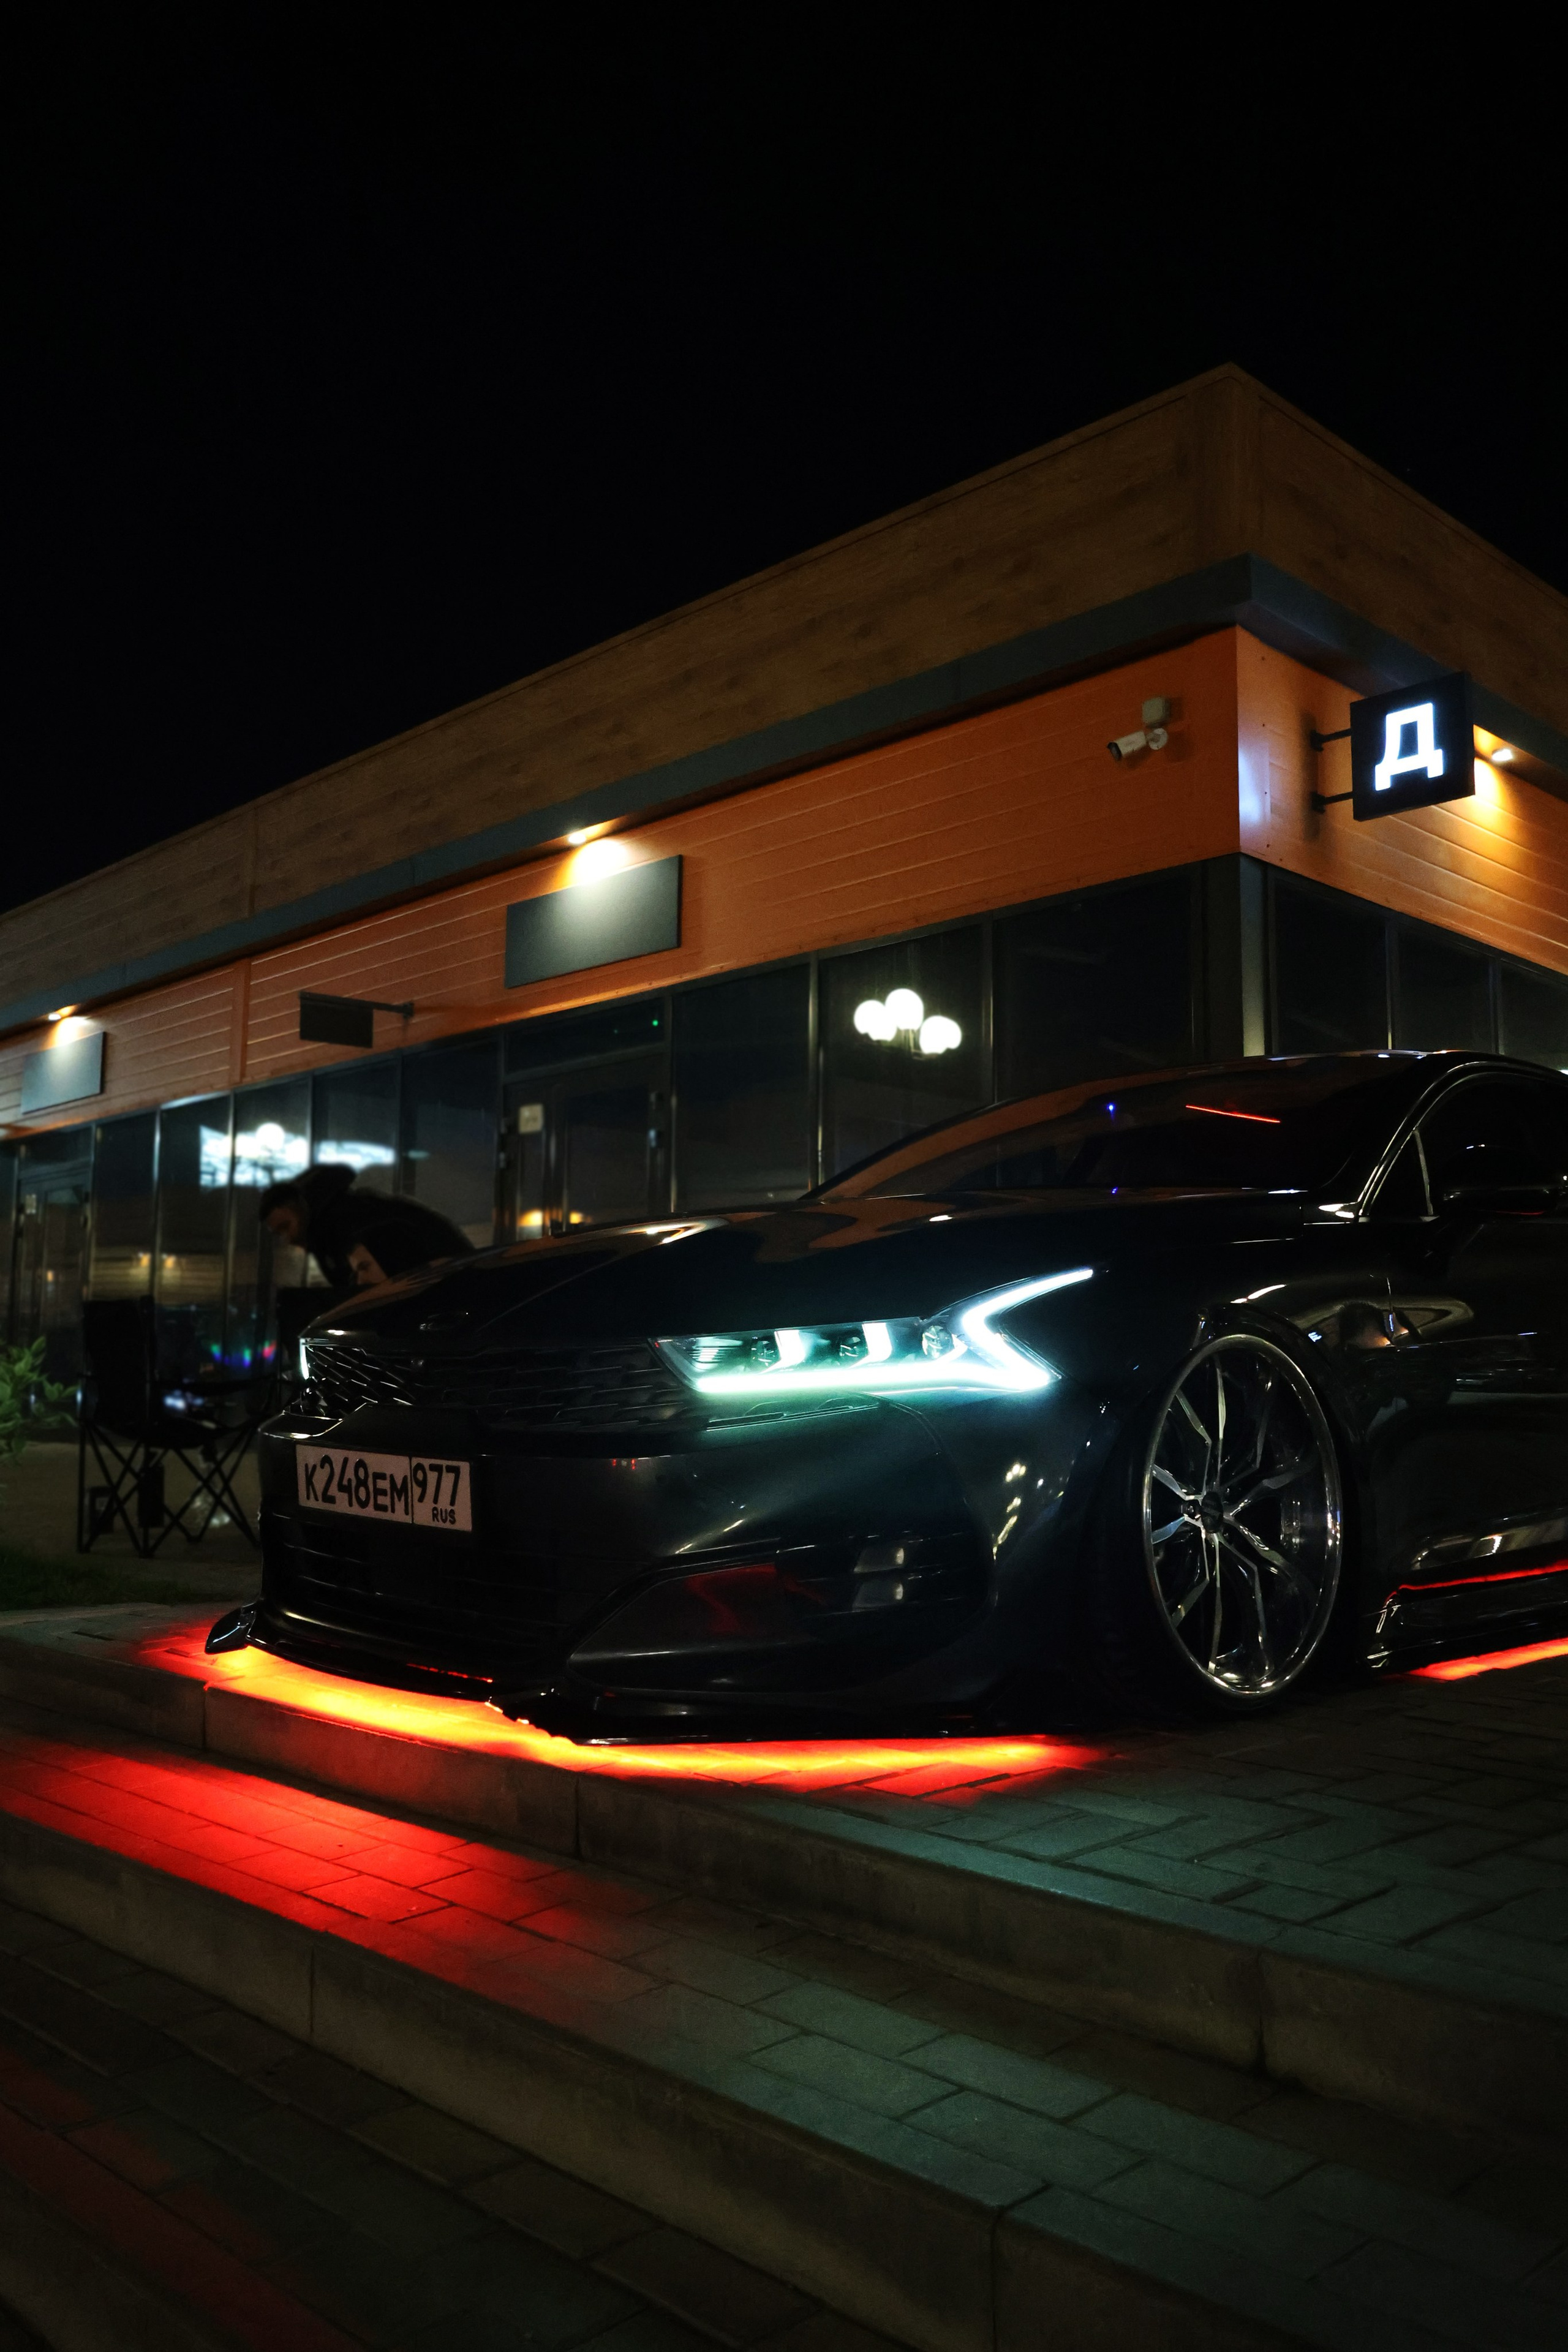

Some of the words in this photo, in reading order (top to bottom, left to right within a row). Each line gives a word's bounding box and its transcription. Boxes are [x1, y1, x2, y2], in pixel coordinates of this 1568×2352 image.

[1374, 702, 1444, 791] Д
[413, 1462, 461, 1506] 977
[432, 1507, 456, 1525] RUS
